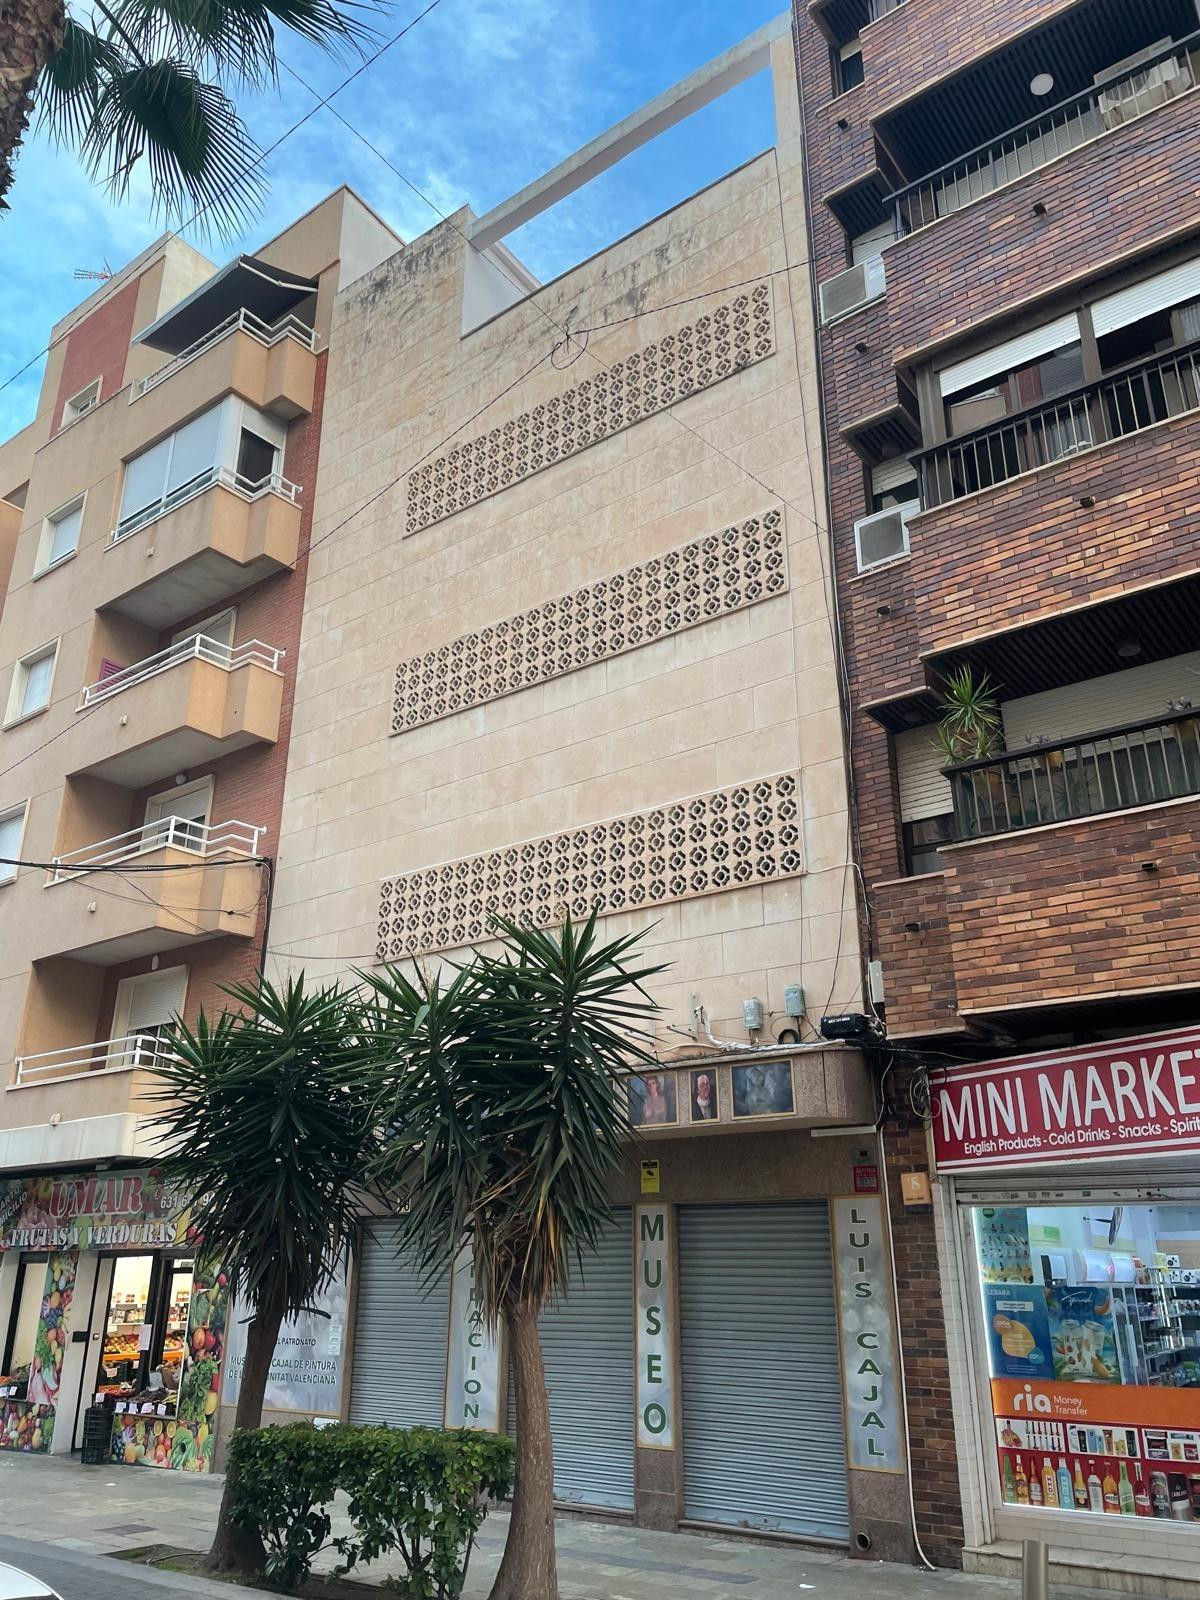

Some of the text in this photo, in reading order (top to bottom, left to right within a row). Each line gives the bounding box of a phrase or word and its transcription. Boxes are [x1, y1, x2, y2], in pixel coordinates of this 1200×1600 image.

[939, 1077, 1029, 1142] MINI
[964, 1139, 997, 1156] English
[998, 1134, 1042, 1150] Products
[1049, 1131, 1076, 1146] Cold
[1077, 1126, 1111, 1143] Drinks
[1118, 1122, 1162, 1139] Snacks
[1170, 1116, 1200, 1135] Spirit
[160, 1195, 178, 1208] 631
[10, 1223, 178, 1247] FRUTAS Y VERDURAS
[848, 1208, 873, 1299] LUIS
[640, 1214, 668, 1435] MUSEO
[281, 1337, 317, 1346] PATRONATO
[230, 1356, 337, 1371] MUS CAJAL DE PINTURA
[228, 1370, 238, 1379] DE
[289, 1374, 336, 1385] VALENCIANA
[856, 1332, 888, 1458] CAJAL
[1013, 1383, 1052, 1413] ria
[1053, 1395, 1083, 1406] Money
[1054, 1405, 1089, 1416] Transfer
